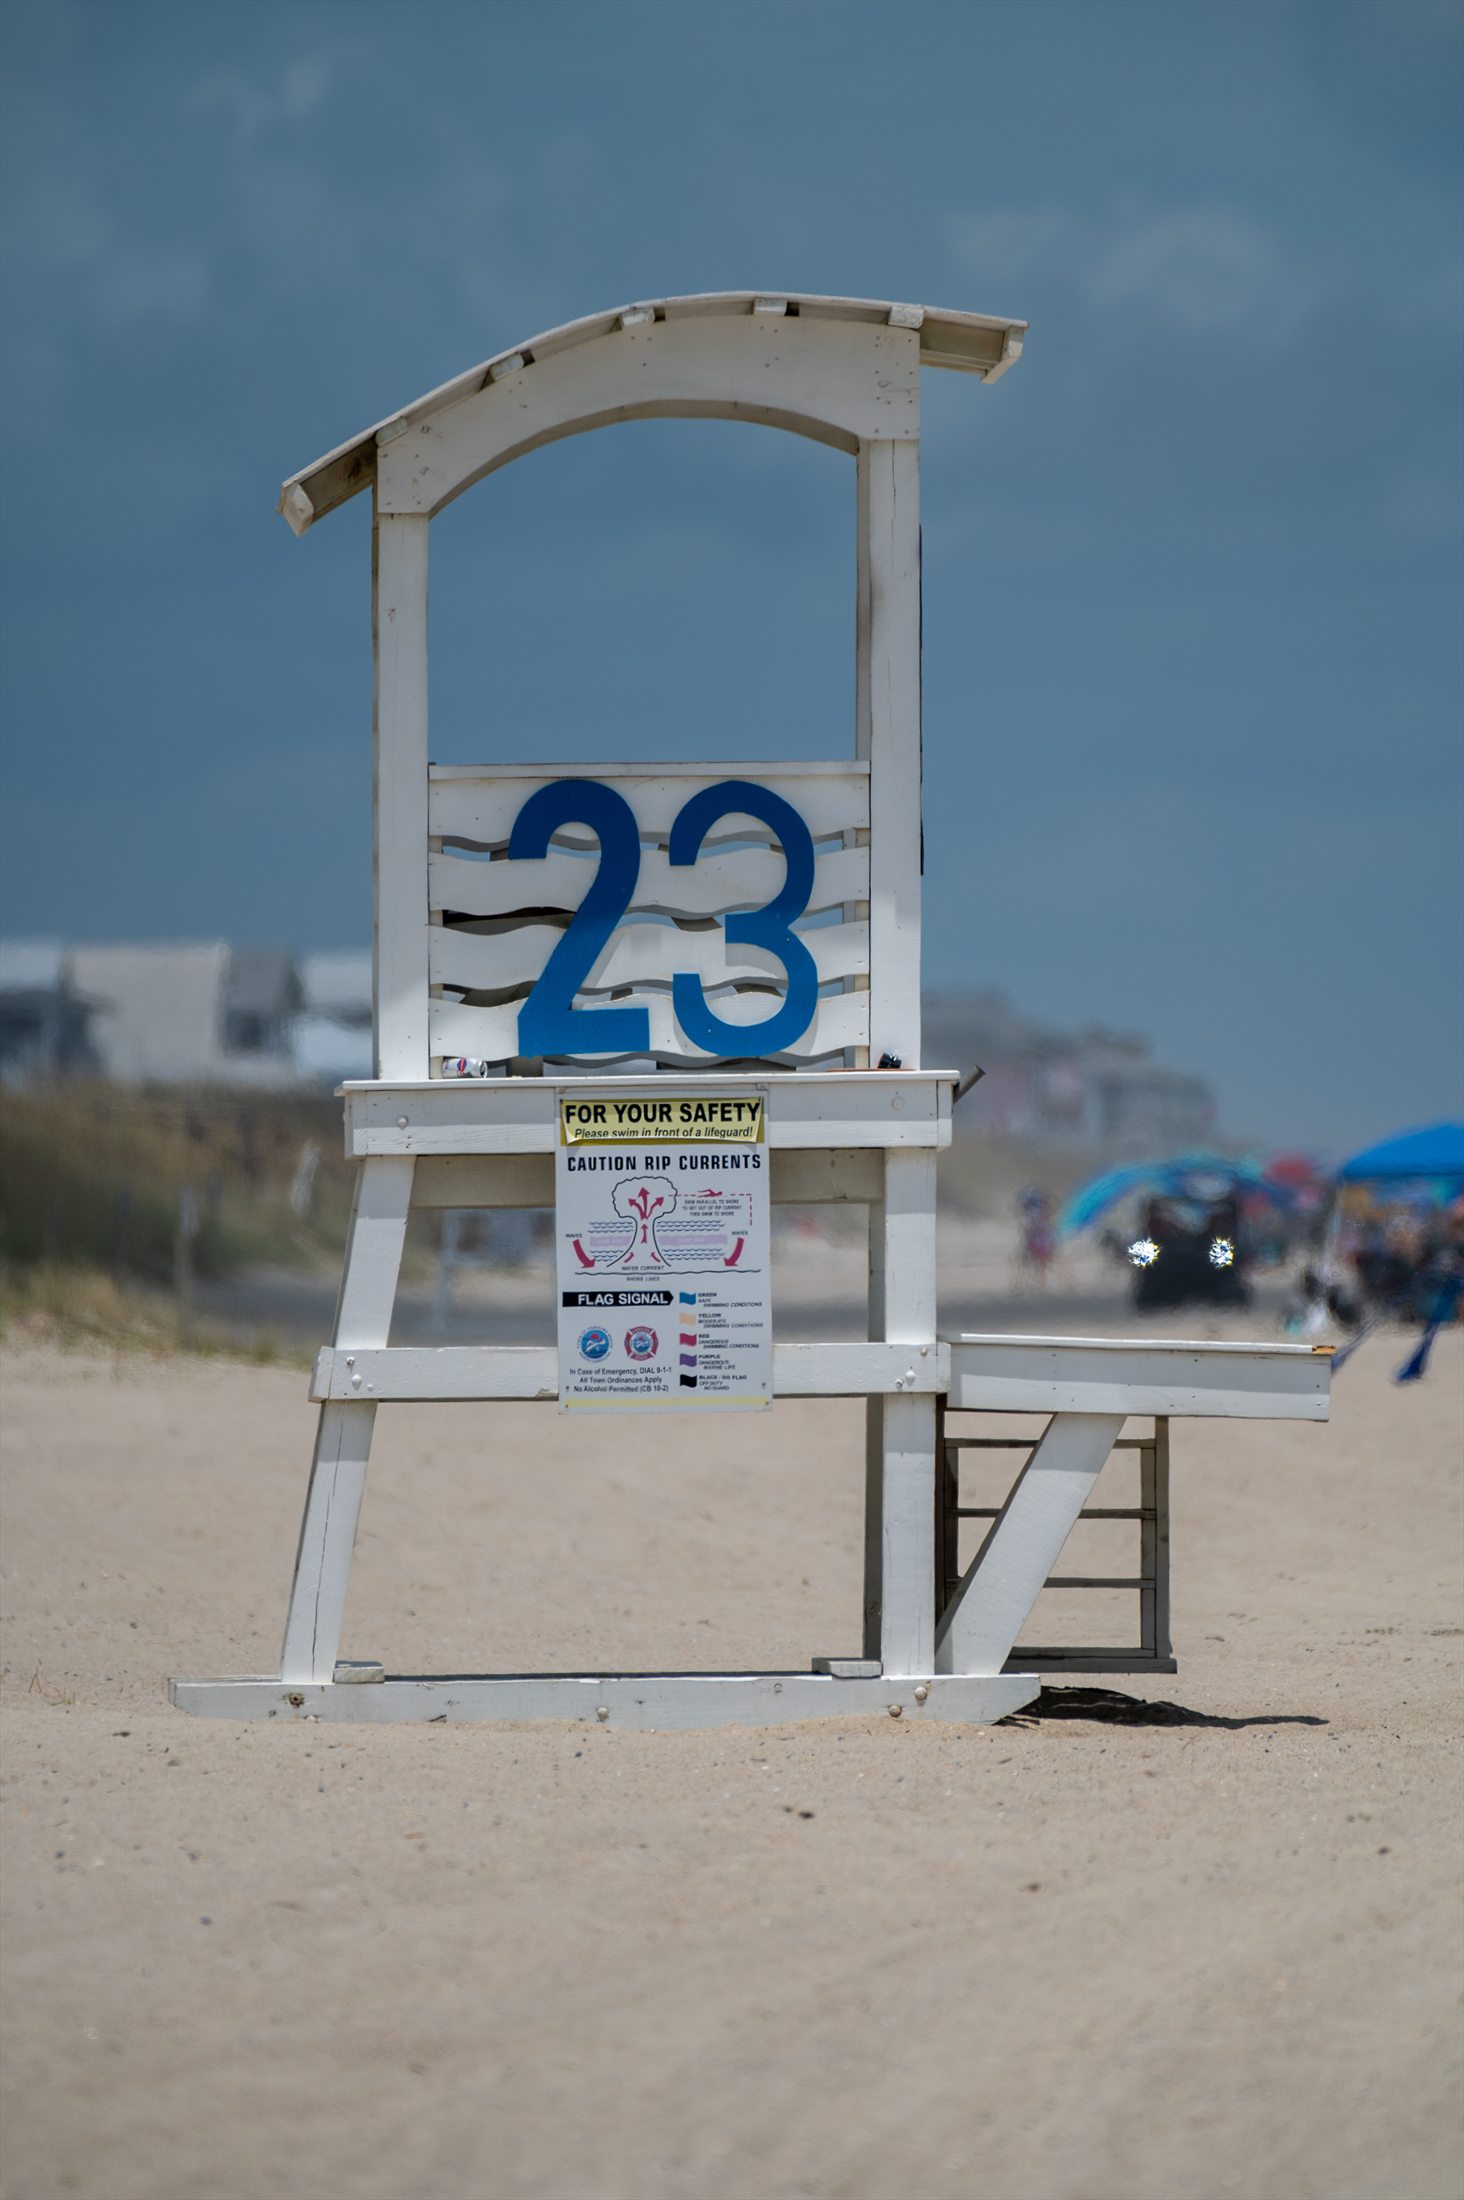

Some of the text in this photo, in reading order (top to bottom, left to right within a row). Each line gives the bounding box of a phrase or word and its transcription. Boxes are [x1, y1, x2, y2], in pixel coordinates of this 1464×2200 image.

[507, 779, 819, 1057] 23
[566, 1103, 760, 1123] FOR YOUR SAFETY
[575, 1126, 752, 1138] Please swim in front of a lifeguard!
[568, 1155, 760, 1171] CAUTION RIP CURRENTS
[578, 1293, 668, 1305] FLAG SIGNAL
[602, 1368, 638, 1376] Emergency,
